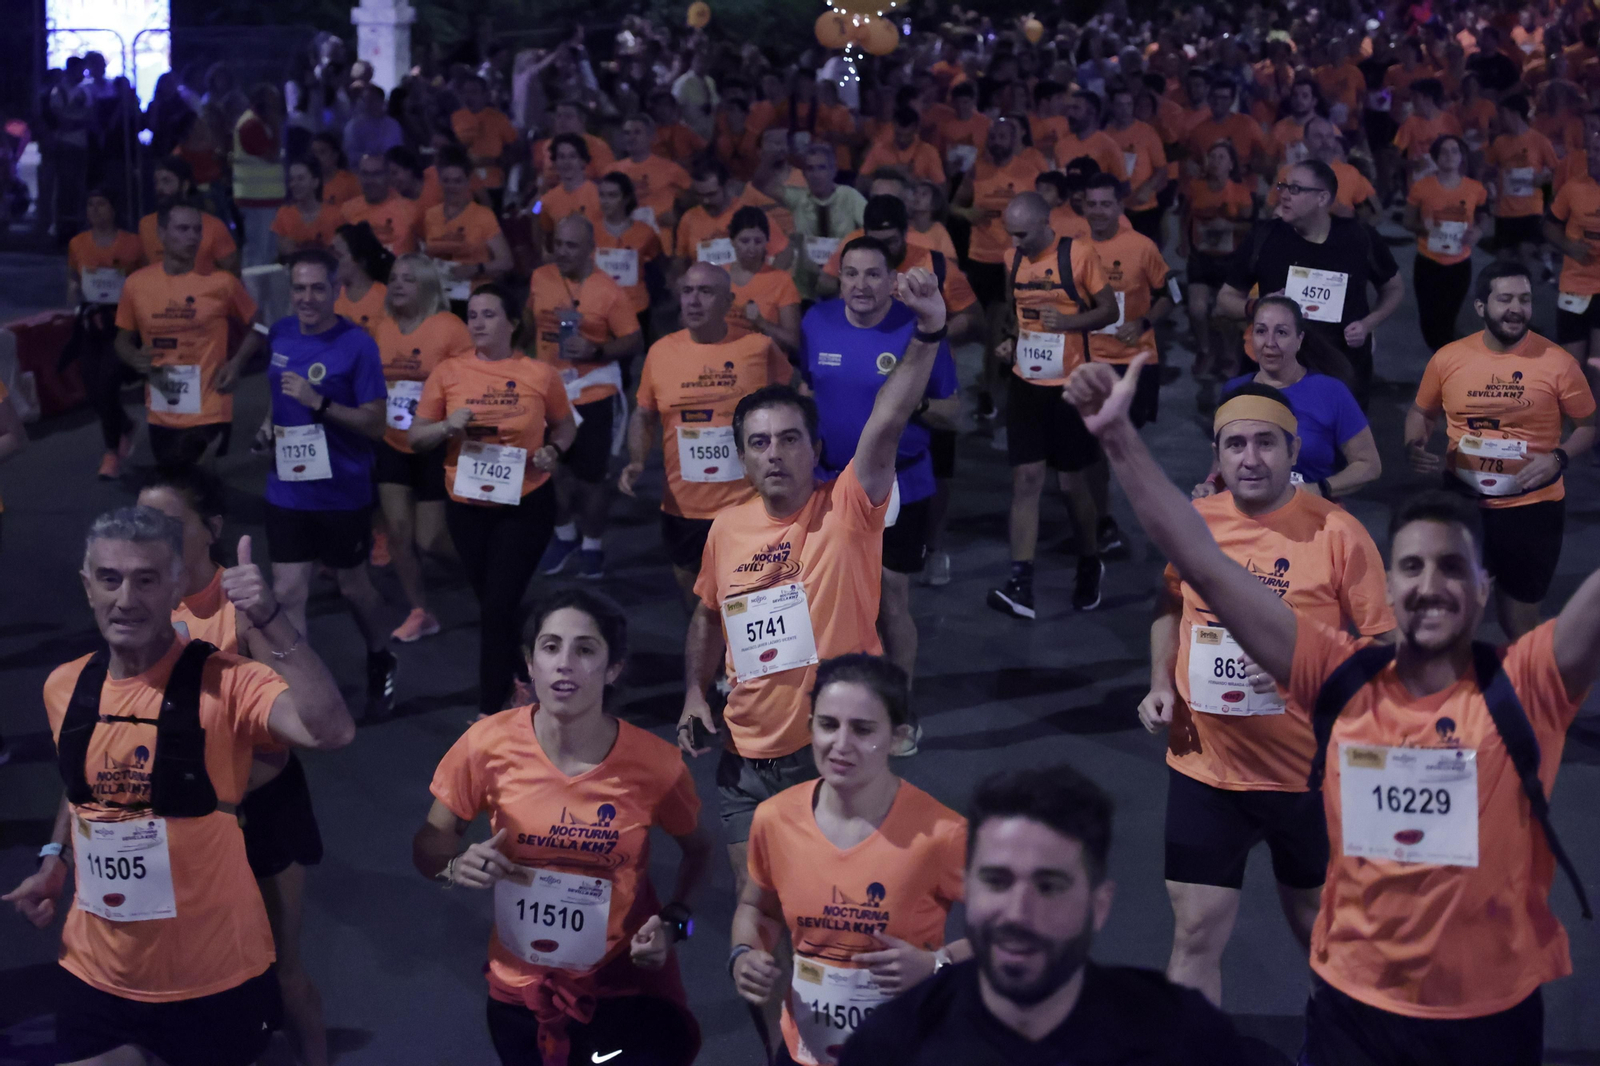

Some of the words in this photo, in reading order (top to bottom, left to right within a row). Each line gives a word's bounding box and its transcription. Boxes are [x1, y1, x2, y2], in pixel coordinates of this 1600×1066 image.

[1302, 286, 1331, 300] 4570
[1023, 347, 1053, 361] 11642
[1467, 390, 1502, 398] SEVILLA
[1503, 391, 1524, 399] KH7
[282, 443, 317, 459] 17376
[689, 445, 730, 460] 15580
[473, 461, 512, 480] 17402
[1479, 457, 1504, 474] 778
[1257, 575, 1290, 589] TURNA
[746, 615, 786, 642] 5741
[1372, 785, 1451, 814] 16229
[549, 825, 620, 840] NOCTURNA
[517, 833, 578, 850] SEVILLA
[579, 840, 618, 854] KH7
[88, 852, 147, 880] 11505
[516, 898, 584, 932] 11510
[823, 905, 890, 921] NOCTURNA
[796, 916, 851, 932] SEVILLA
[852, 922, 888, 935] KH7
